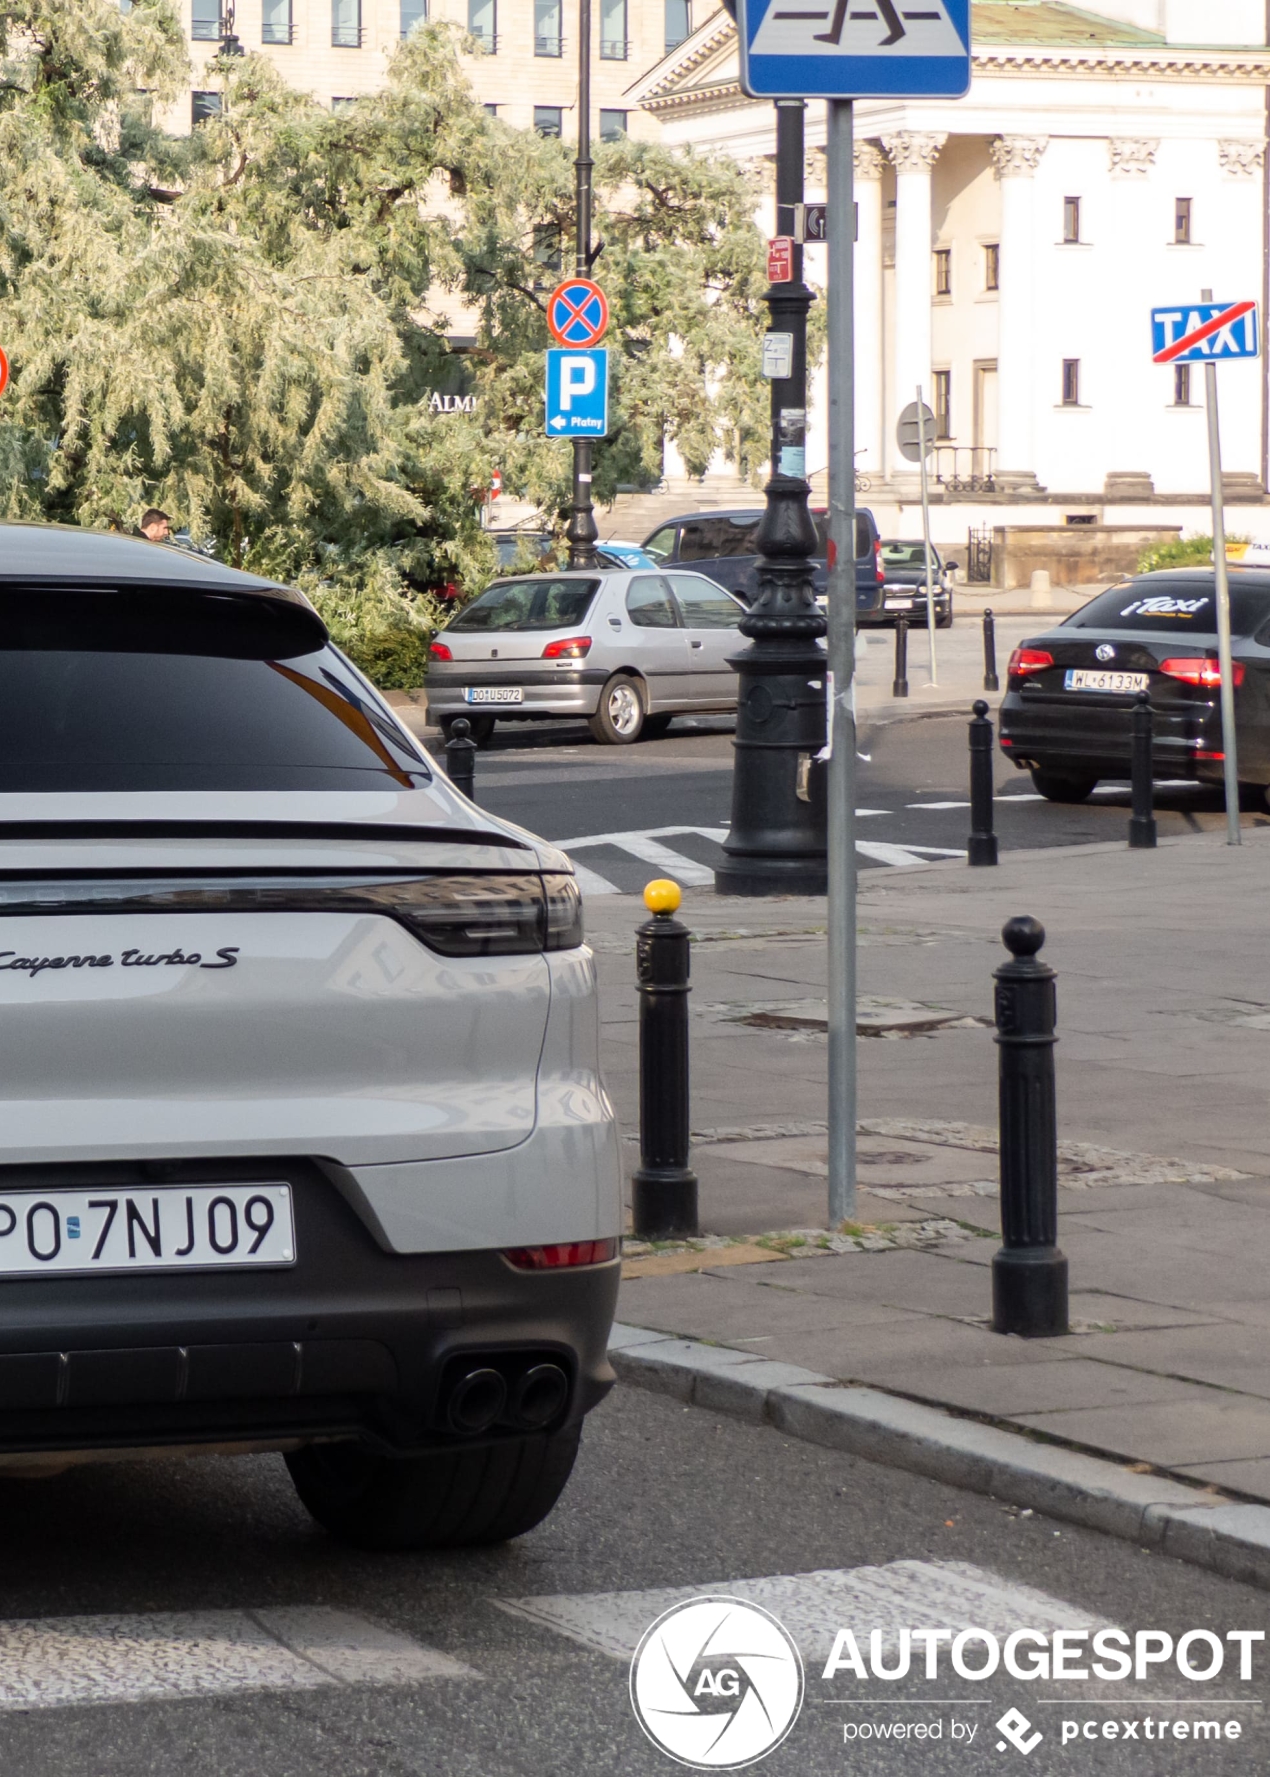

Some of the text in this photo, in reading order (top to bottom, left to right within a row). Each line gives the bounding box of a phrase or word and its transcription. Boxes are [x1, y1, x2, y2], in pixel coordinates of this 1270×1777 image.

[1154, 308, 1255, 356] TAXI
[559, 356, 596, 411] P
[1120, 596, 1209, 616] iTaxi
[1075, 671, 1143, 691] WL 6133M
[121, 948, 202, 967] turbo
[199, 947, 240, 968] S
[88, 1194, 275, 1260] 7NJ09
